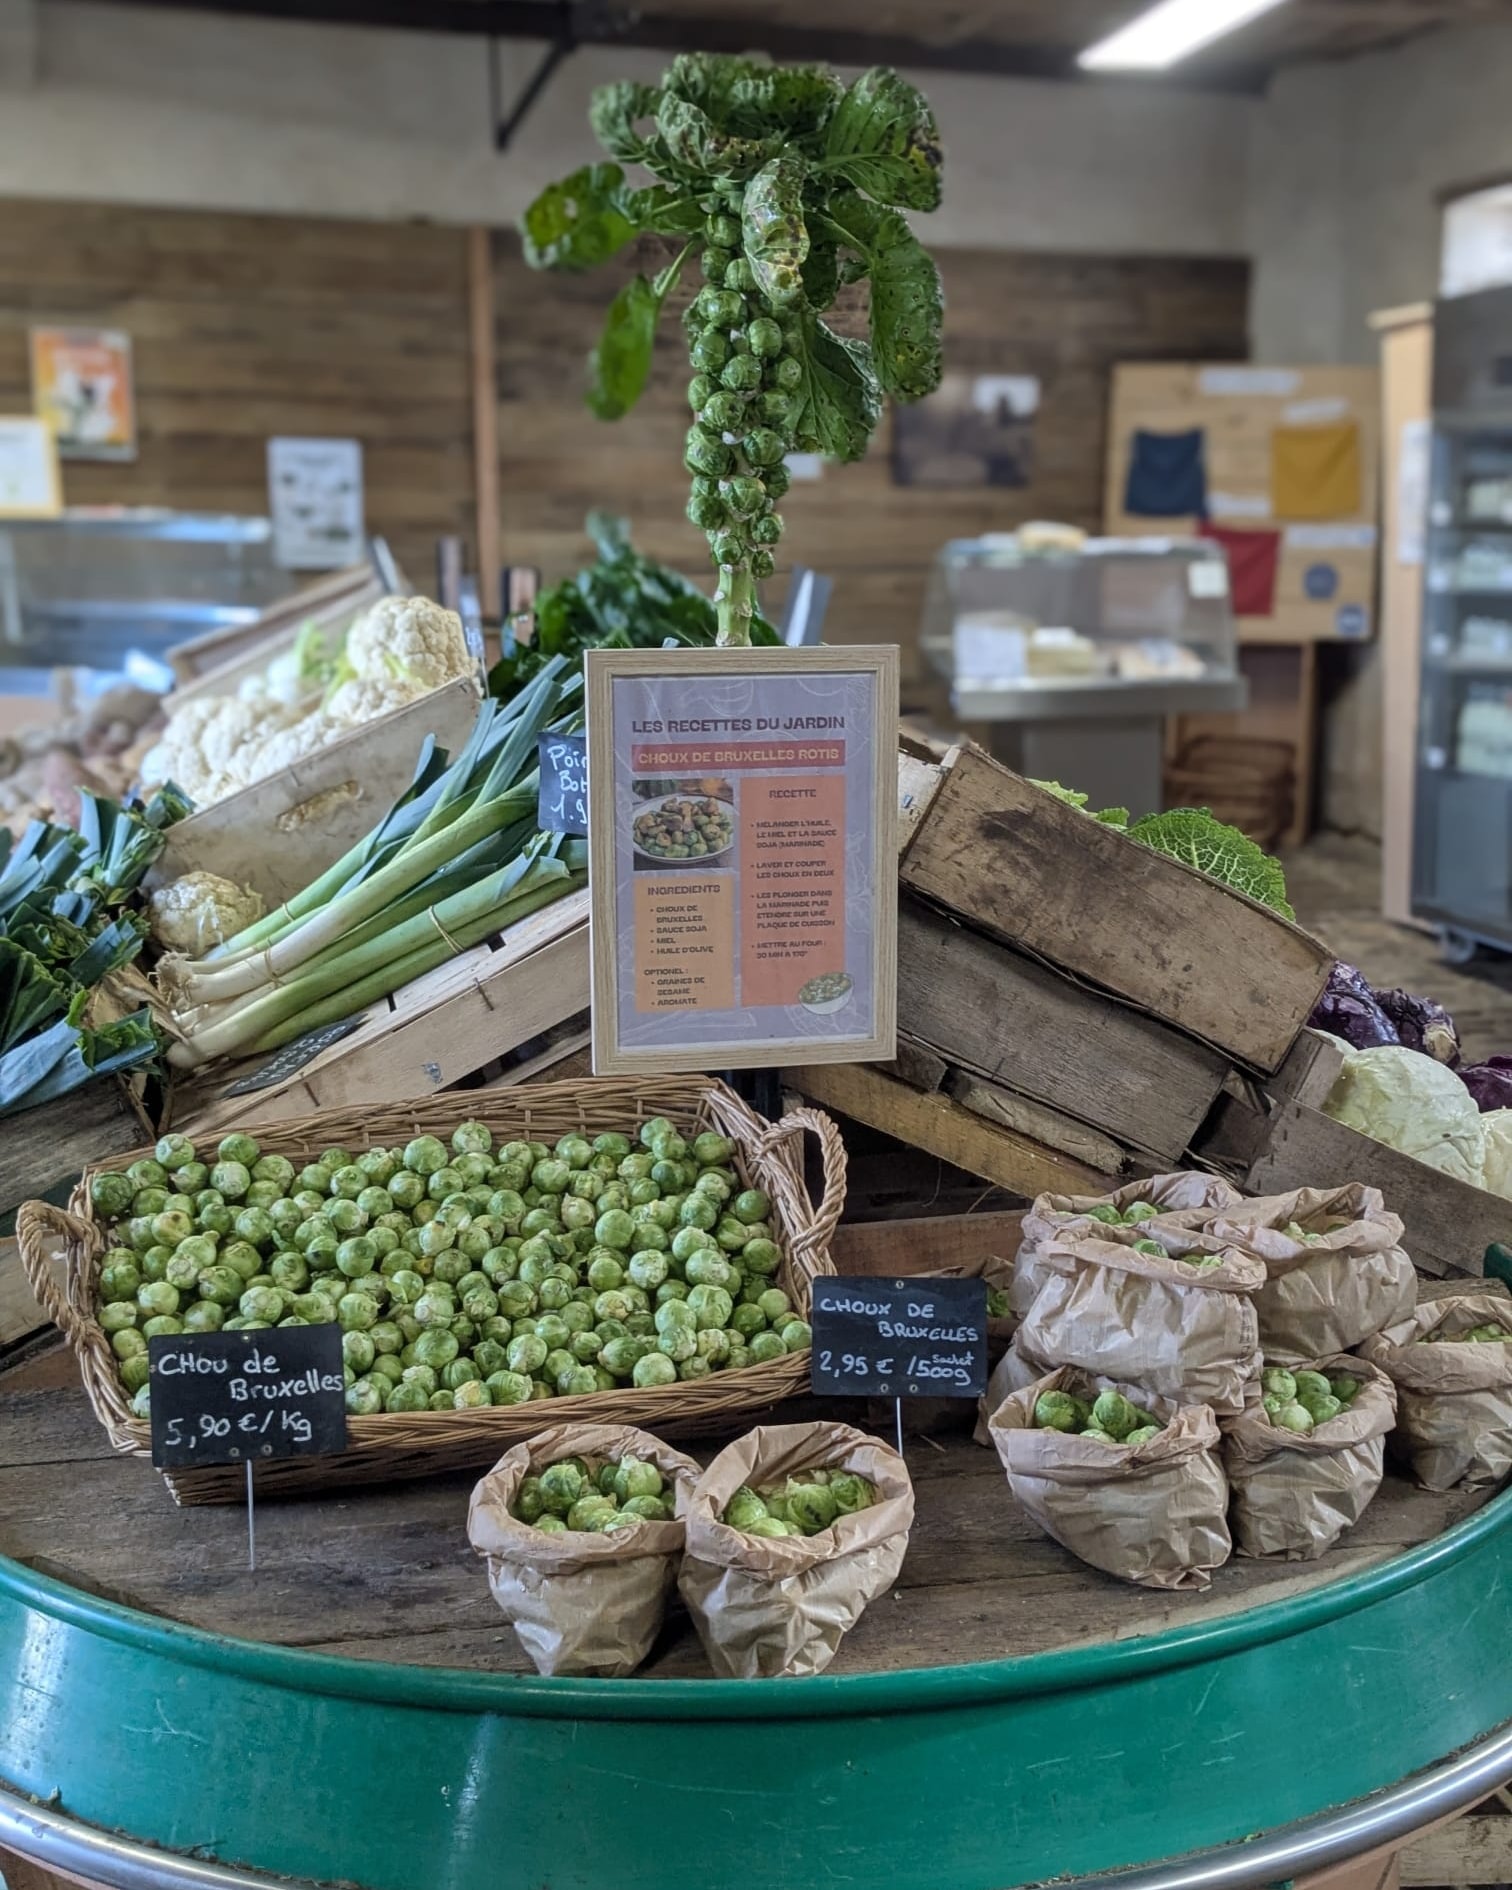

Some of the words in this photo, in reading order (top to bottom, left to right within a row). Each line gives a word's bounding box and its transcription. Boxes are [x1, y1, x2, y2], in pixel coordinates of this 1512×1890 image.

[632, 720, 663, 733] LES
[667, 717, 751, 733] RECETTES
[756, 717, 779, 731] DU
[783, 716, 845, 730] JARDIN
[638, 752, 689, 765] CHOUX
[692, 751, 711, 763] DE
[714, 750, 795, 763] BRUXELLES
[799, 748, 839, 760] ROTIS
[769, 789, 816, 798] RECETTE
[647, 885, 720, 896] INGREDIENTS
[772, 891, 808, 899] PLONGER
[656, 916, 703, 924] BRUXELLES
[656, 947, 680, 955] HUILE
[681, 946, 714, 954] D'OLIVE
[789, 940, 800, 948] AU
[644, 968, 683, 976] OPTIONEL
[819, 1297, 892, 1317] CHOUX
[907, 1303, 935, 1319] DE
[242, 1347, 281, 1375] de
[819, 1350, 870, 1378] 2,95
[875, 1358, 895, 1374] €
[228, 1368, 343, 1401] Bruxelles
[164, 1413, 232, 1449] 5,90
